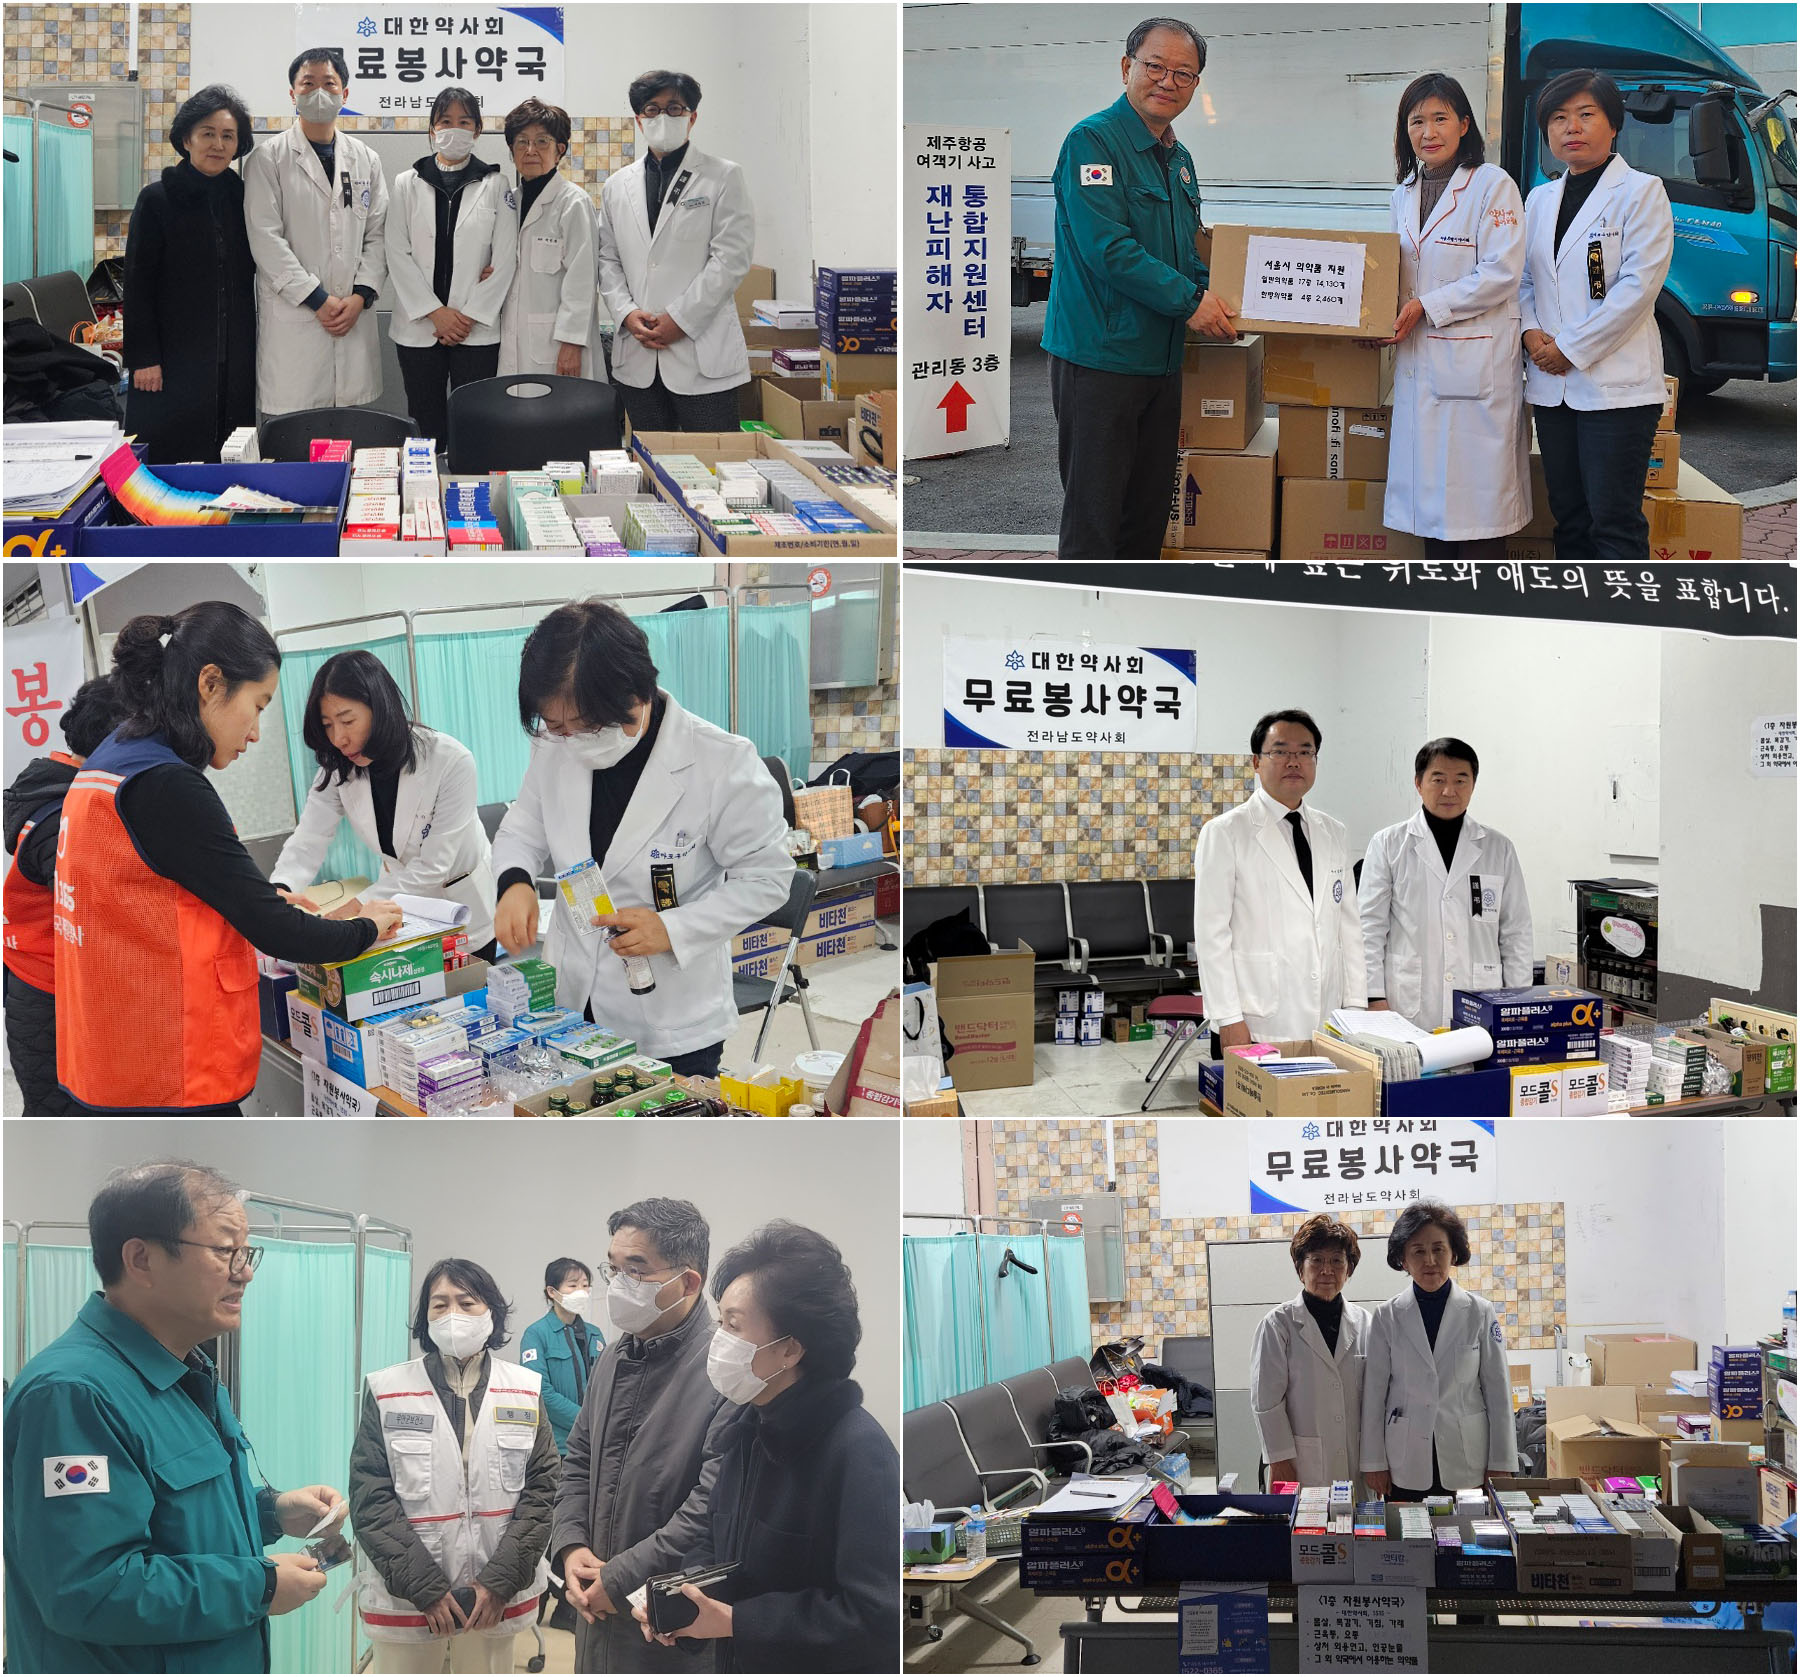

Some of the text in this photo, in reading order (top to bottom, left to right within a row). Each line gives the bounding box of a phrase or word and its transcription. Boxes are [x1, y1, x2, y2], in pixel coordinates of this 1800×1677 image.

[384, 16, 504, 36] 대한약사회
[327, 47, 547, 83] 료봉사약국
[926, 135, 987, 152] 제주항공
[916, 153, 996, 170] 여객기 사고
[926, 184, 953, 314] 재난피해자
[962, 184, 989, 339] 통합지원센터
[1265, 260, 1345, 275] 서울시 의약품 지원
[911, 354, 1000, 380] 관리동 3층
[1497, 562, 1589, 598] 애도의
[1603, 569, 1662, 602] 뜻을
[1675, 577, 1789, 615] 표합니다.
[1032, 651, 1144, 674] 대한약사회
[5, 662, 63, 748] 봉
[963, 678, 1181, 720] 무료봉사약국
[1027, 730, 1126, 744] 전라남도약사회
[819, 905, 847, 929] 비타천
[742, 930, 768, 952] 비타천
[816, 935, 846, 958] 비타천
[369, 963, 414, 984] 속시나제
[1326, 1120, 1437, 1138] 대한약사회
[1266, 1140, 1479, 1182] 무료봉사약국
[1323, 1189, 1420, 1205] 전라남도약사회
